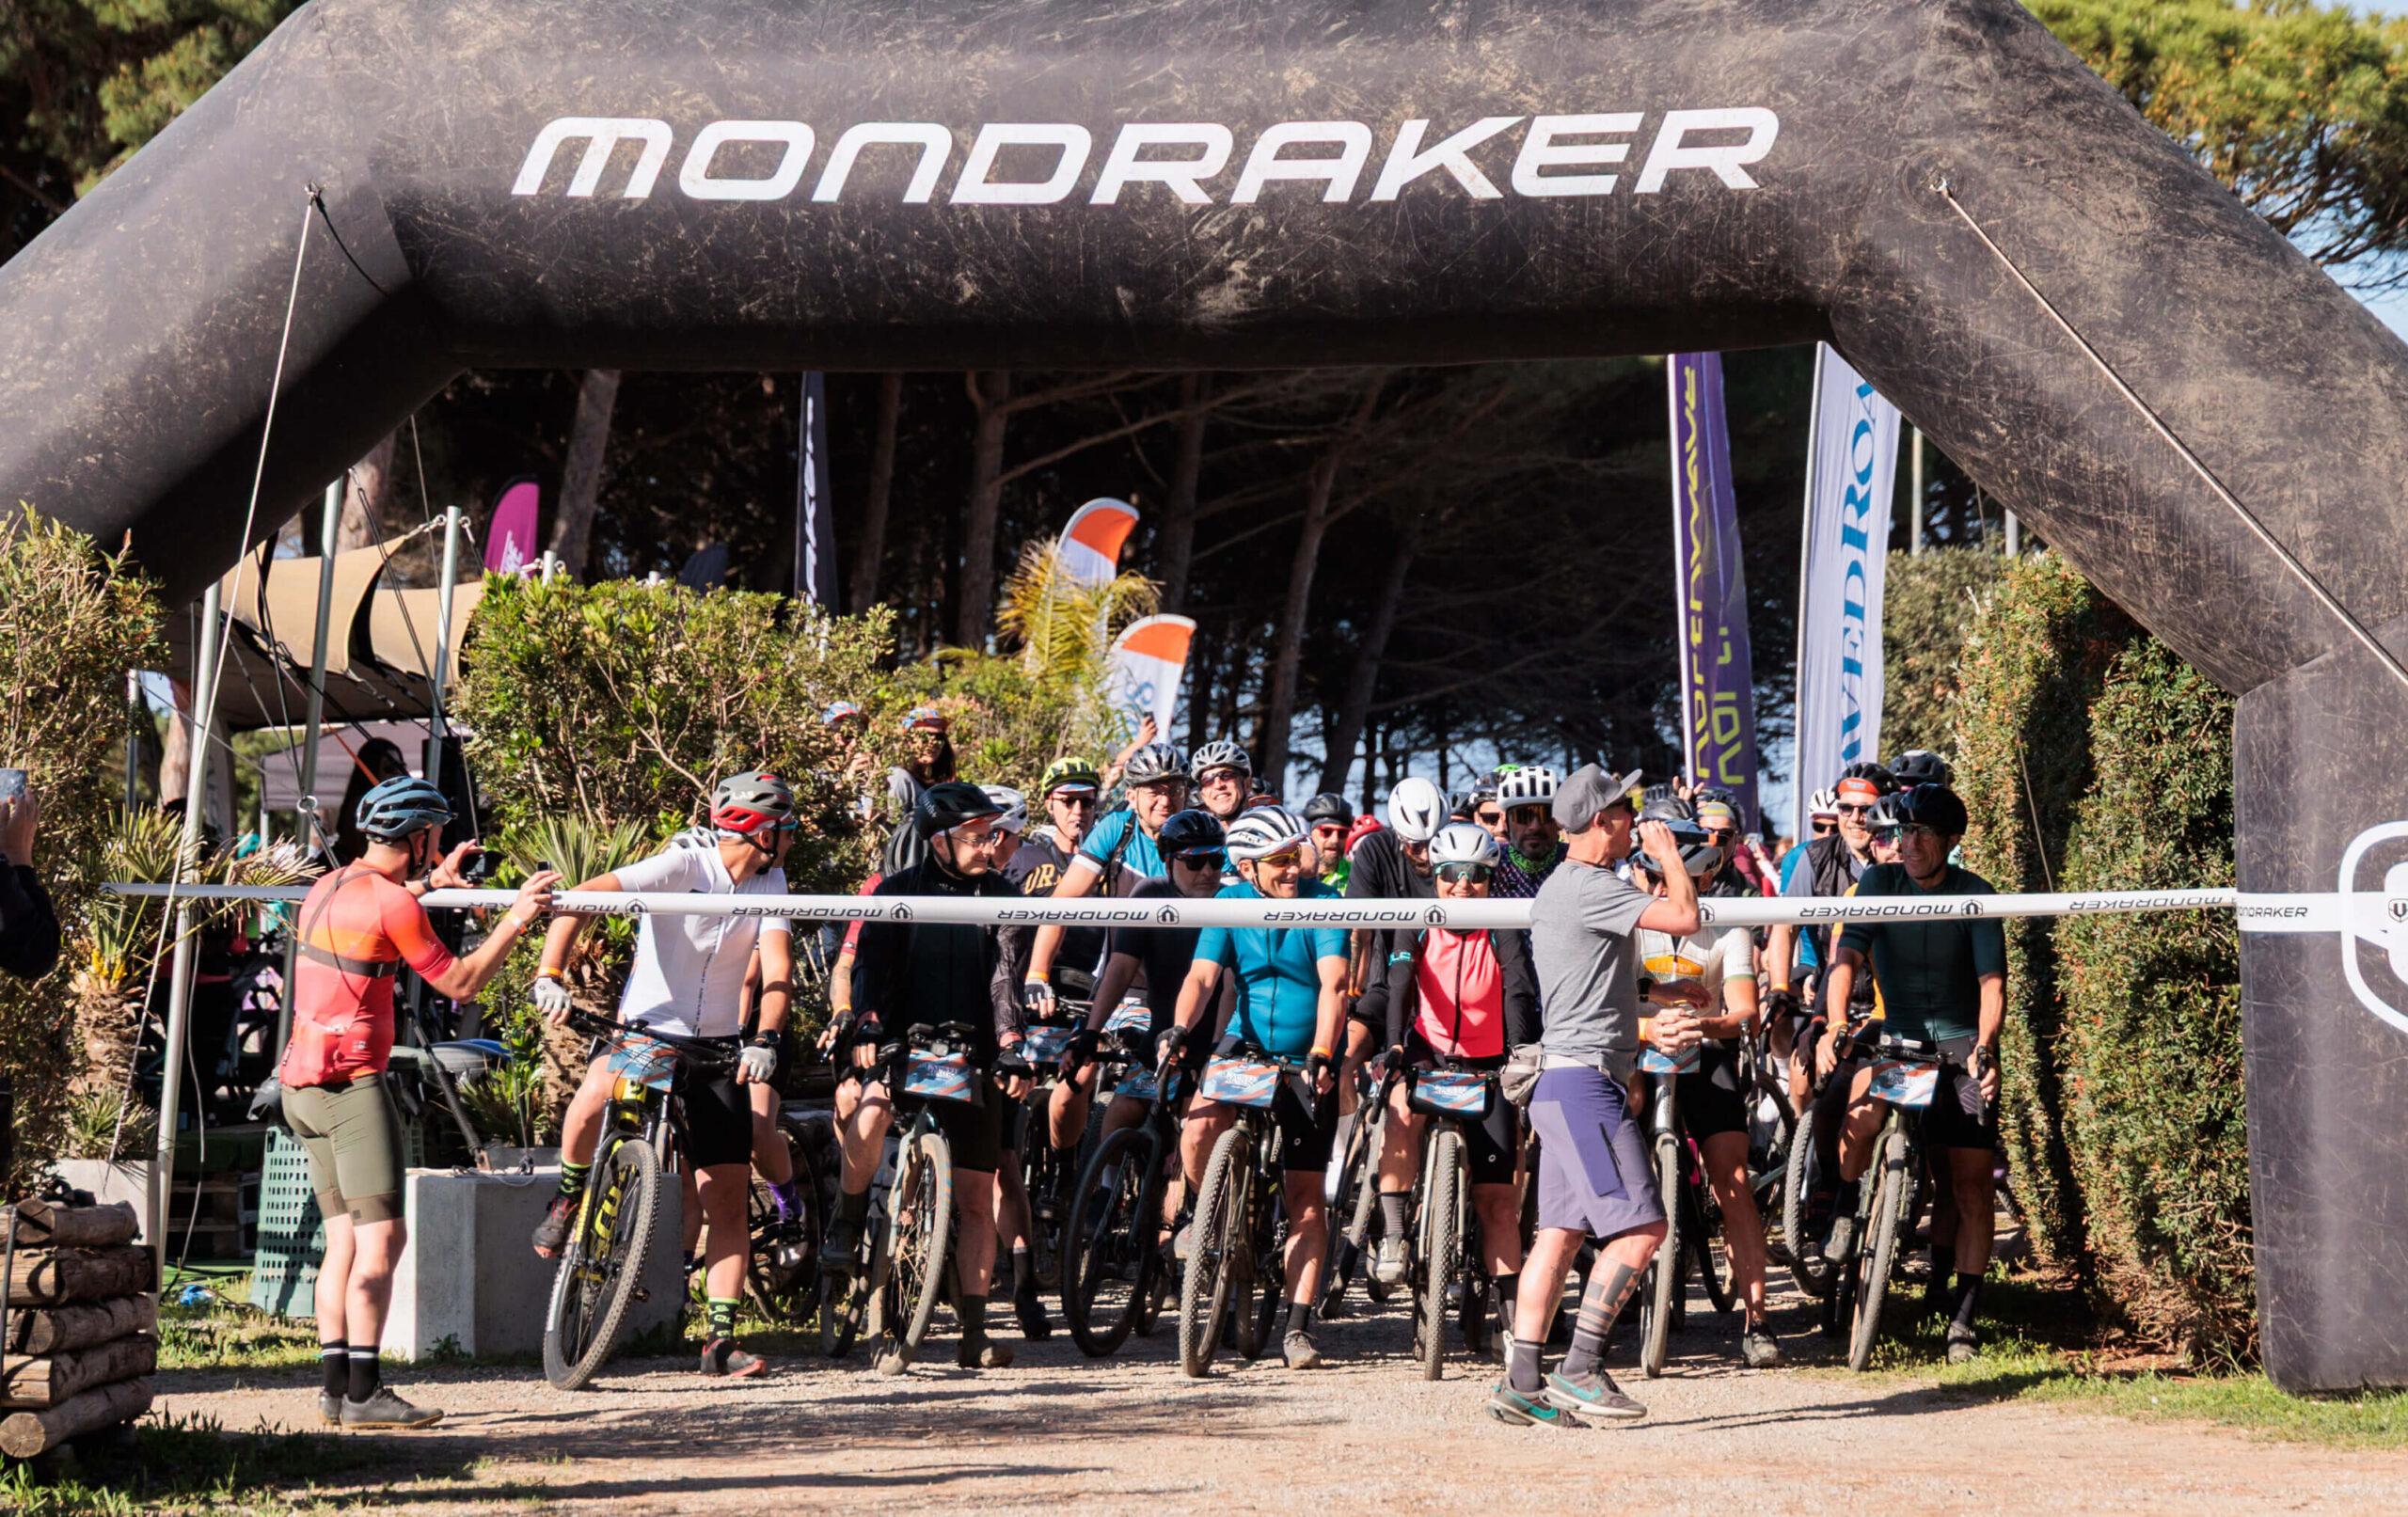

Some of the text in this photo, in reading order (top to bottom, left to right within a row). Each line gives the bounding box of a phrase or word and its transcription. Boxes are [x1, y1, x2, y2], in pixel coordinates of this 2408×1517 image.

[511, 106, 1780, 205] MONDRAKER
[2069, 896, 2223, 910] MONDRAKER
[732, 907, 883, 918] MONDRAKER
[997, 909, 1149, 921] MONDRAKER
[1263, 911, 1417, 922] MONDRAKER
[1800, 905, 1954, 918] MONDRAKER
[2237, 907, 2308, 918] ONDRAKER
